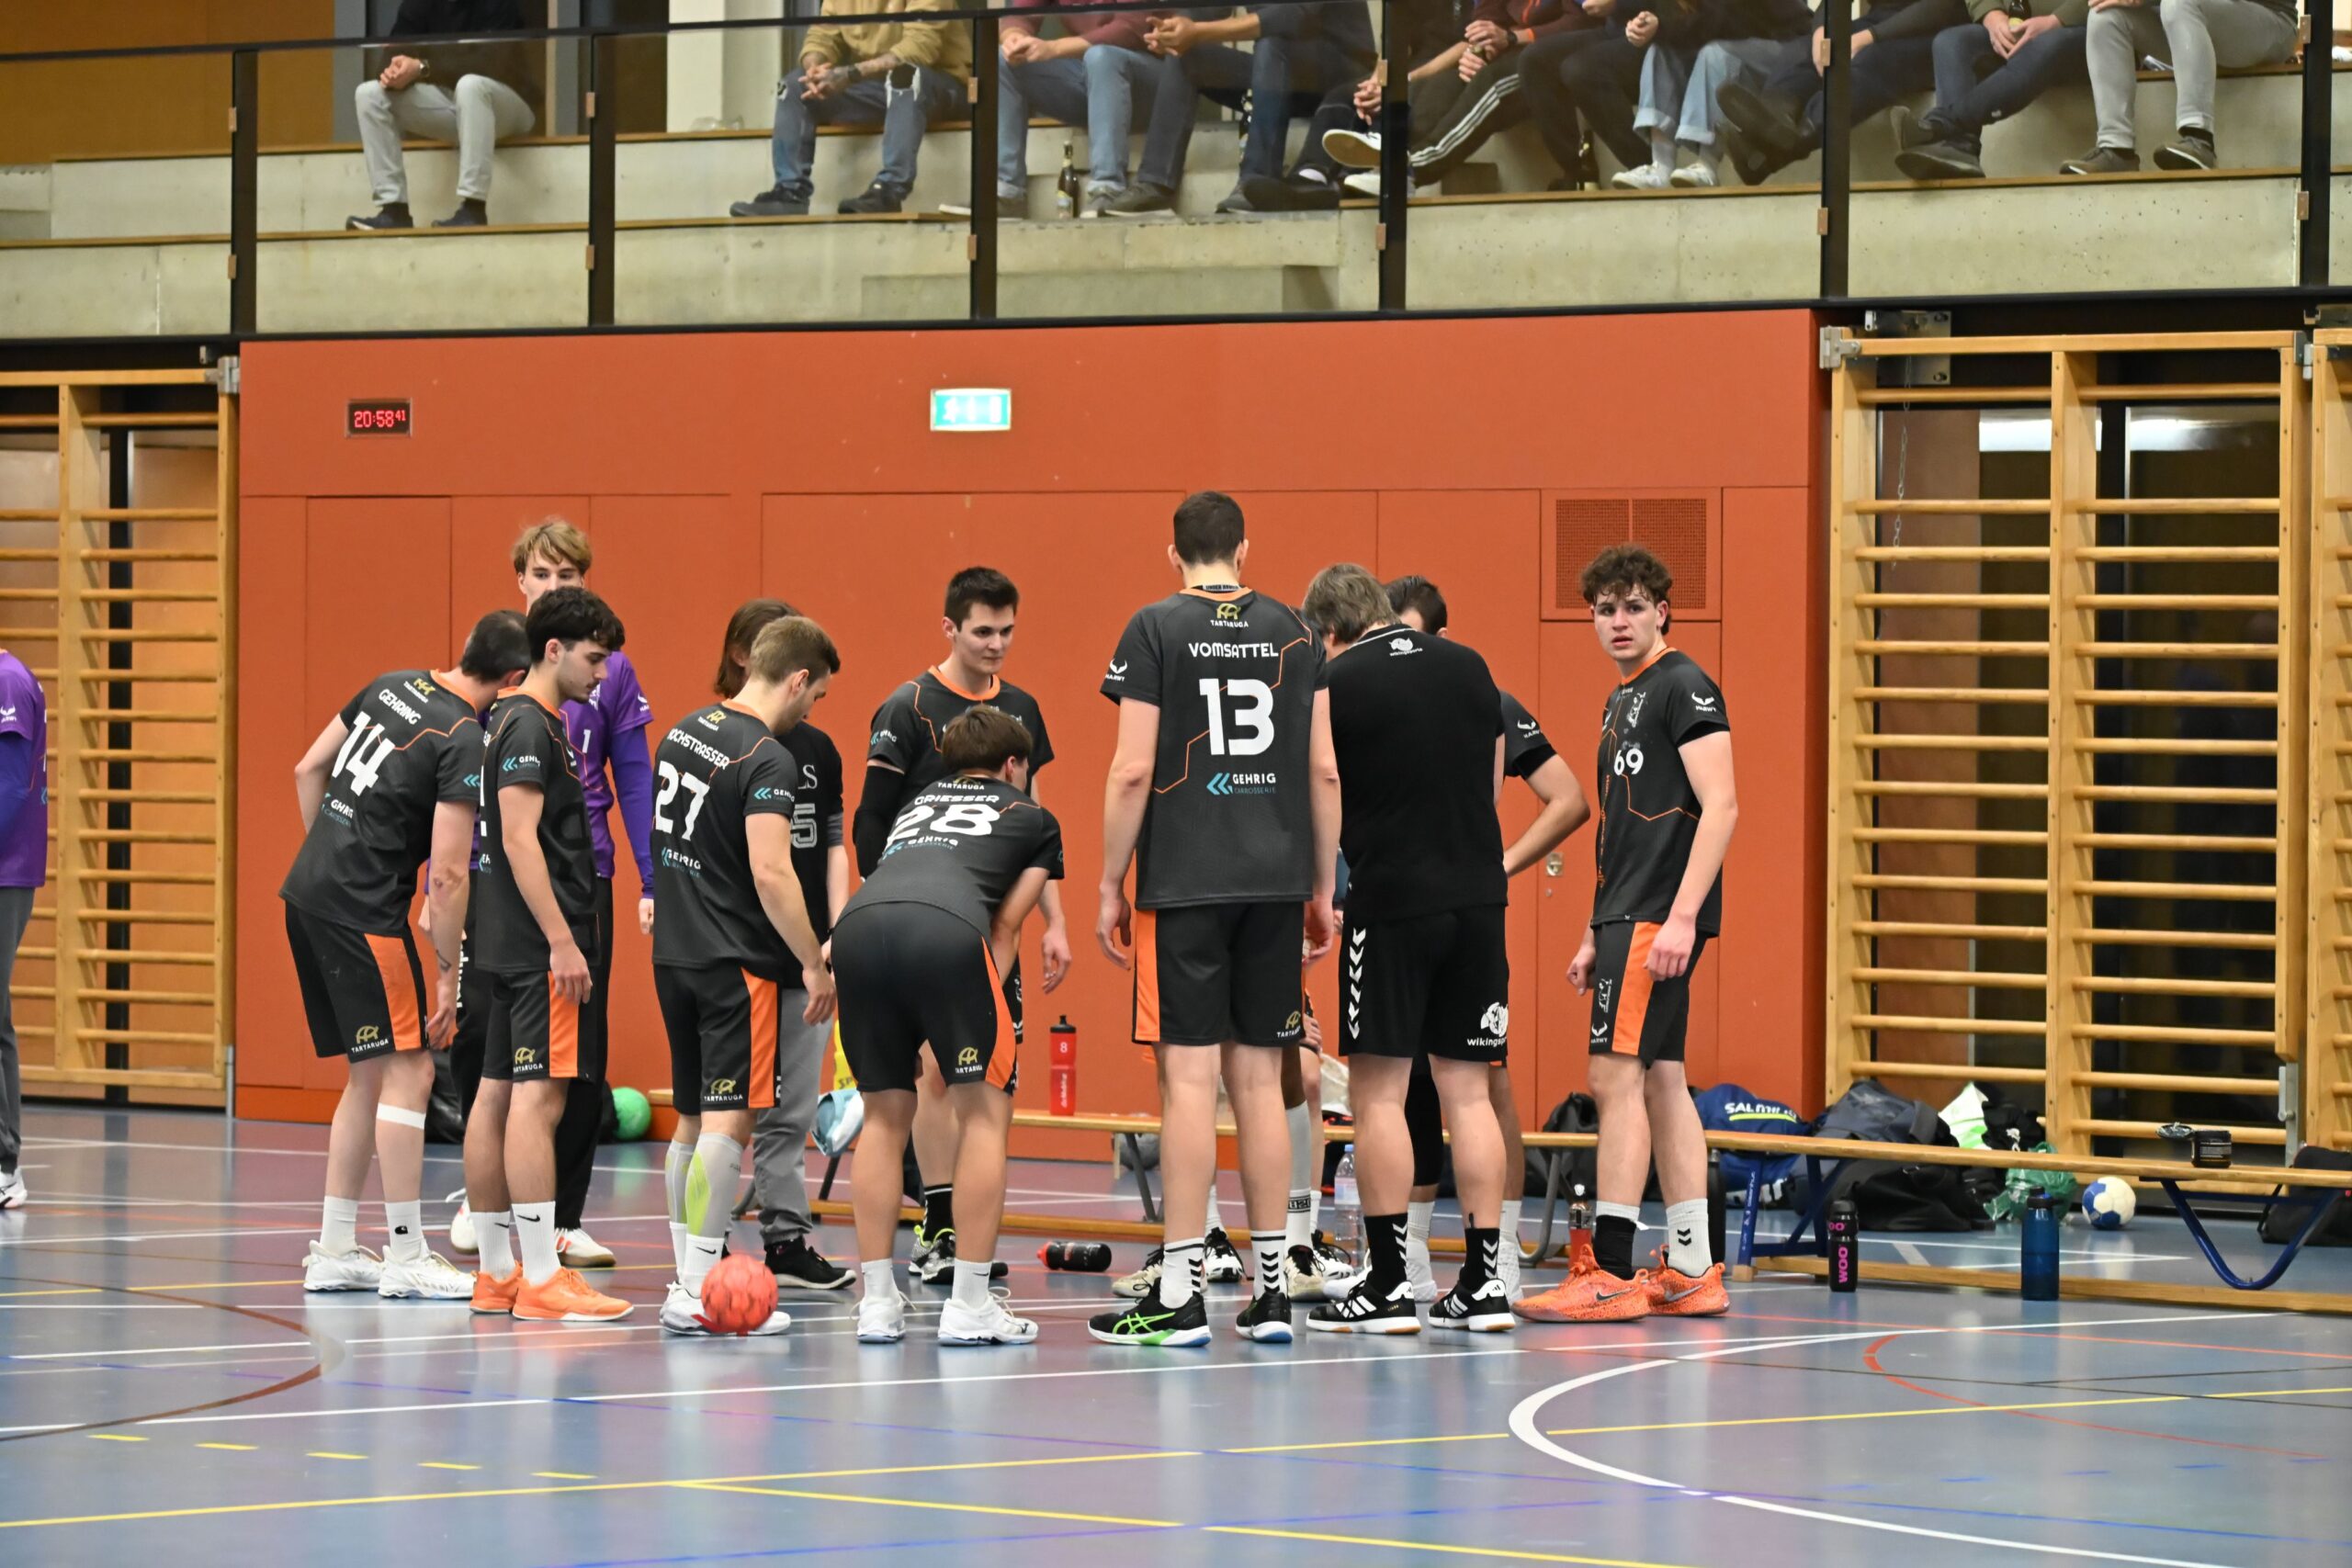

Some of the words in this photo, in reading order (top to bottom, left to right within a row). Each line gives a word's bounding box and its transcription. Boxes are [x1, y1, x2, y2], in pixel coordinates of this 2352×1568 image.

[354, 410, 394, 428] 20:58
[395, 410, 407, 422] 41
[1210, 619, 1250, 628] TARTARUGA
[1188, 642, 1279, 658] VOMSATTEL
[379, 688, 422, 725] GEHRING
[1199, 678, 1275, 756] 13
[332, 711, 396, 796] 14
[1613, 748, 1645, 776] 69
[938, 782, 985, 790] TARTARUGA
[1232, 773, 1277, 784] GEHRIG
[655, 760, 710, 841] 27
[914, 794, 1001, 806] GRIESSER
[883, 803, 1001, 852] 28
[351, 1038, 390, 1054] TARTARUGA
[1466, 1037, 1507, 1047] wikingsp
